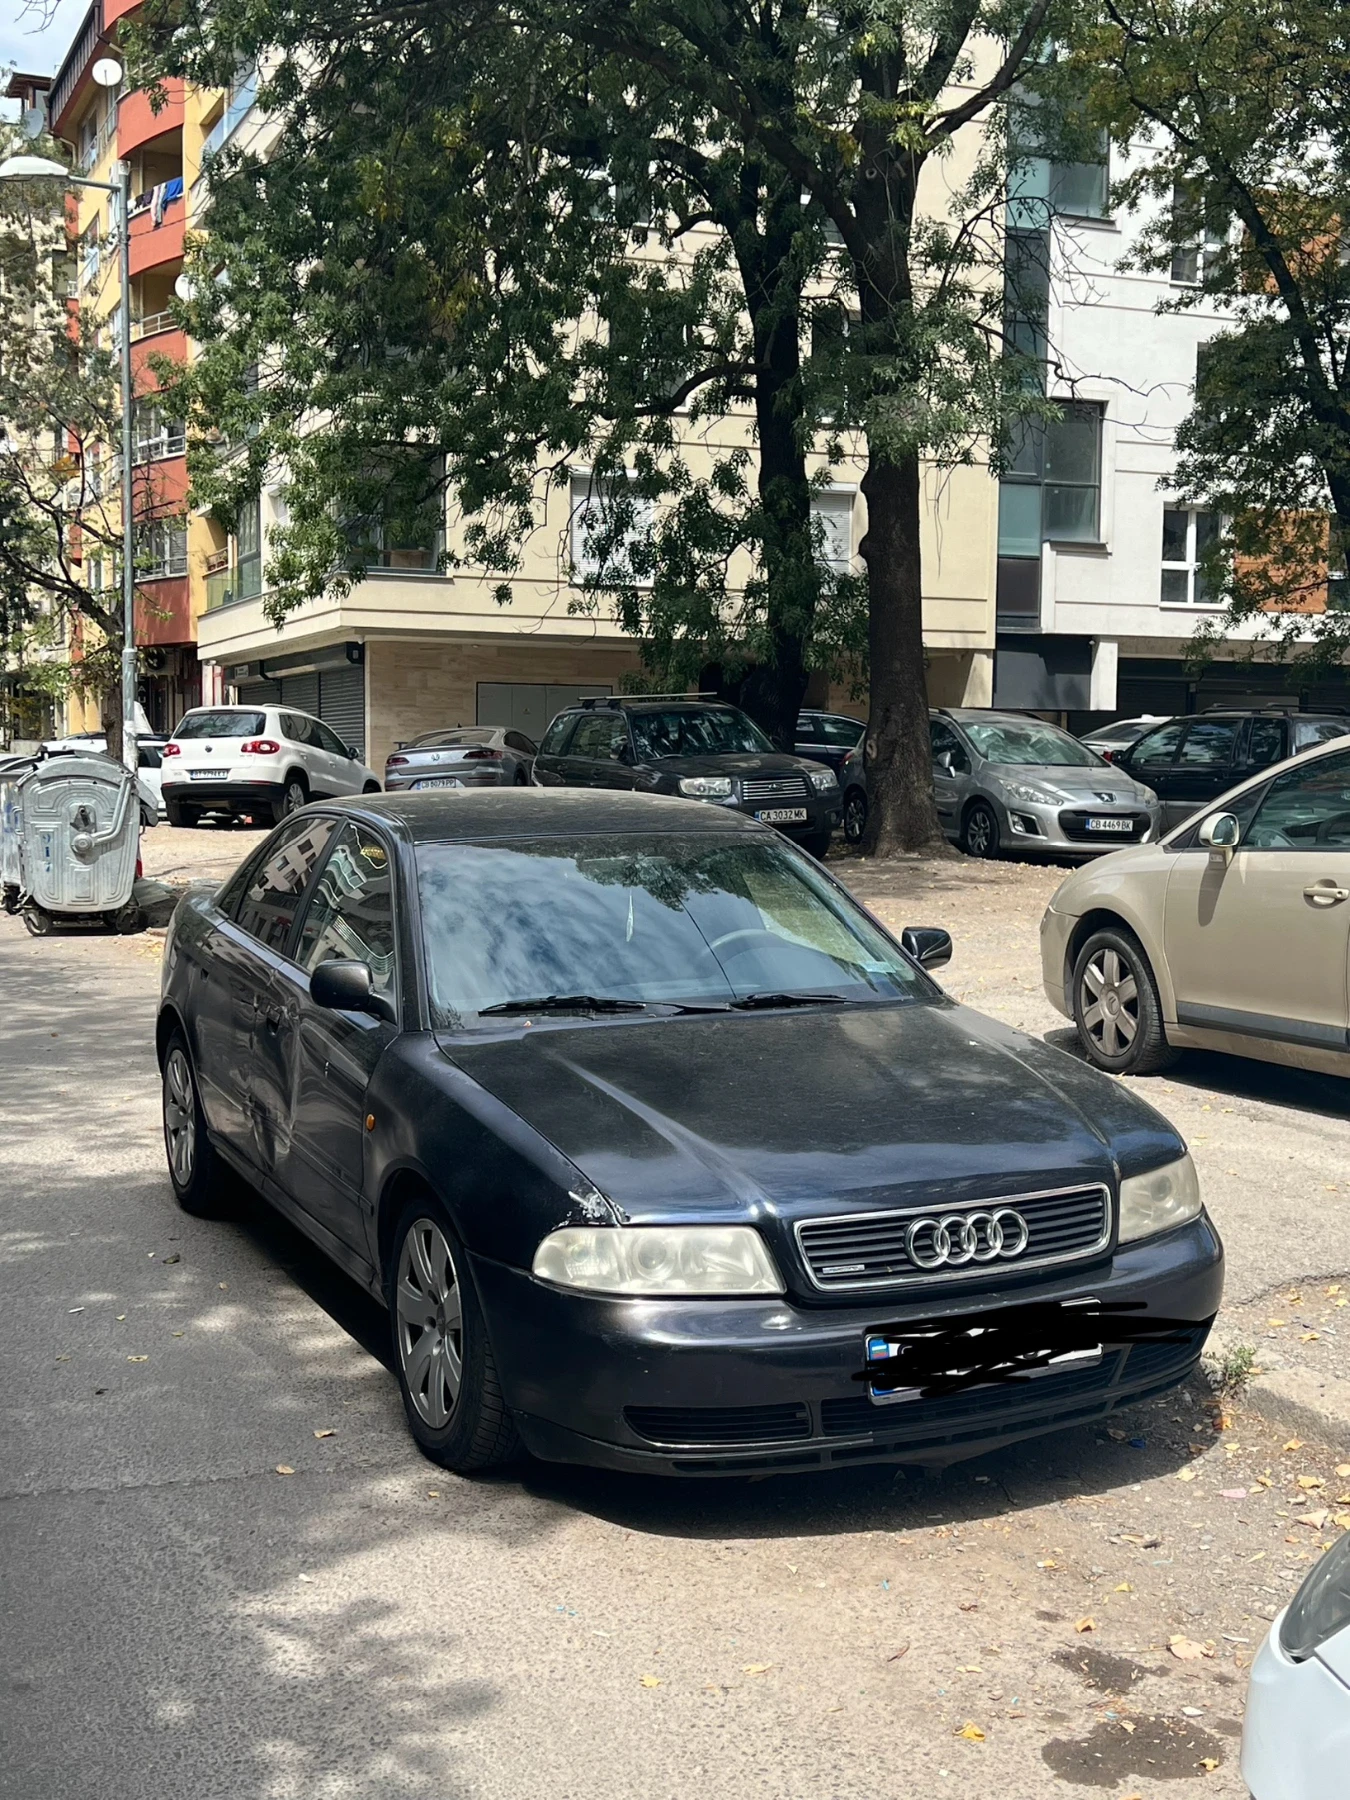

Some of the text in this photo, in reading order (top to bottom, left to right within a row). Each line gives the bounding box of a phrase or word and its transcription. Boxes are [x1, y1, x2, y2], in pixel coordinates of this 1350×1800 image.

[760, 809, 805, 821] CA 3032 MK
[1091, 820, 1131, 831] CB 4469 BK
